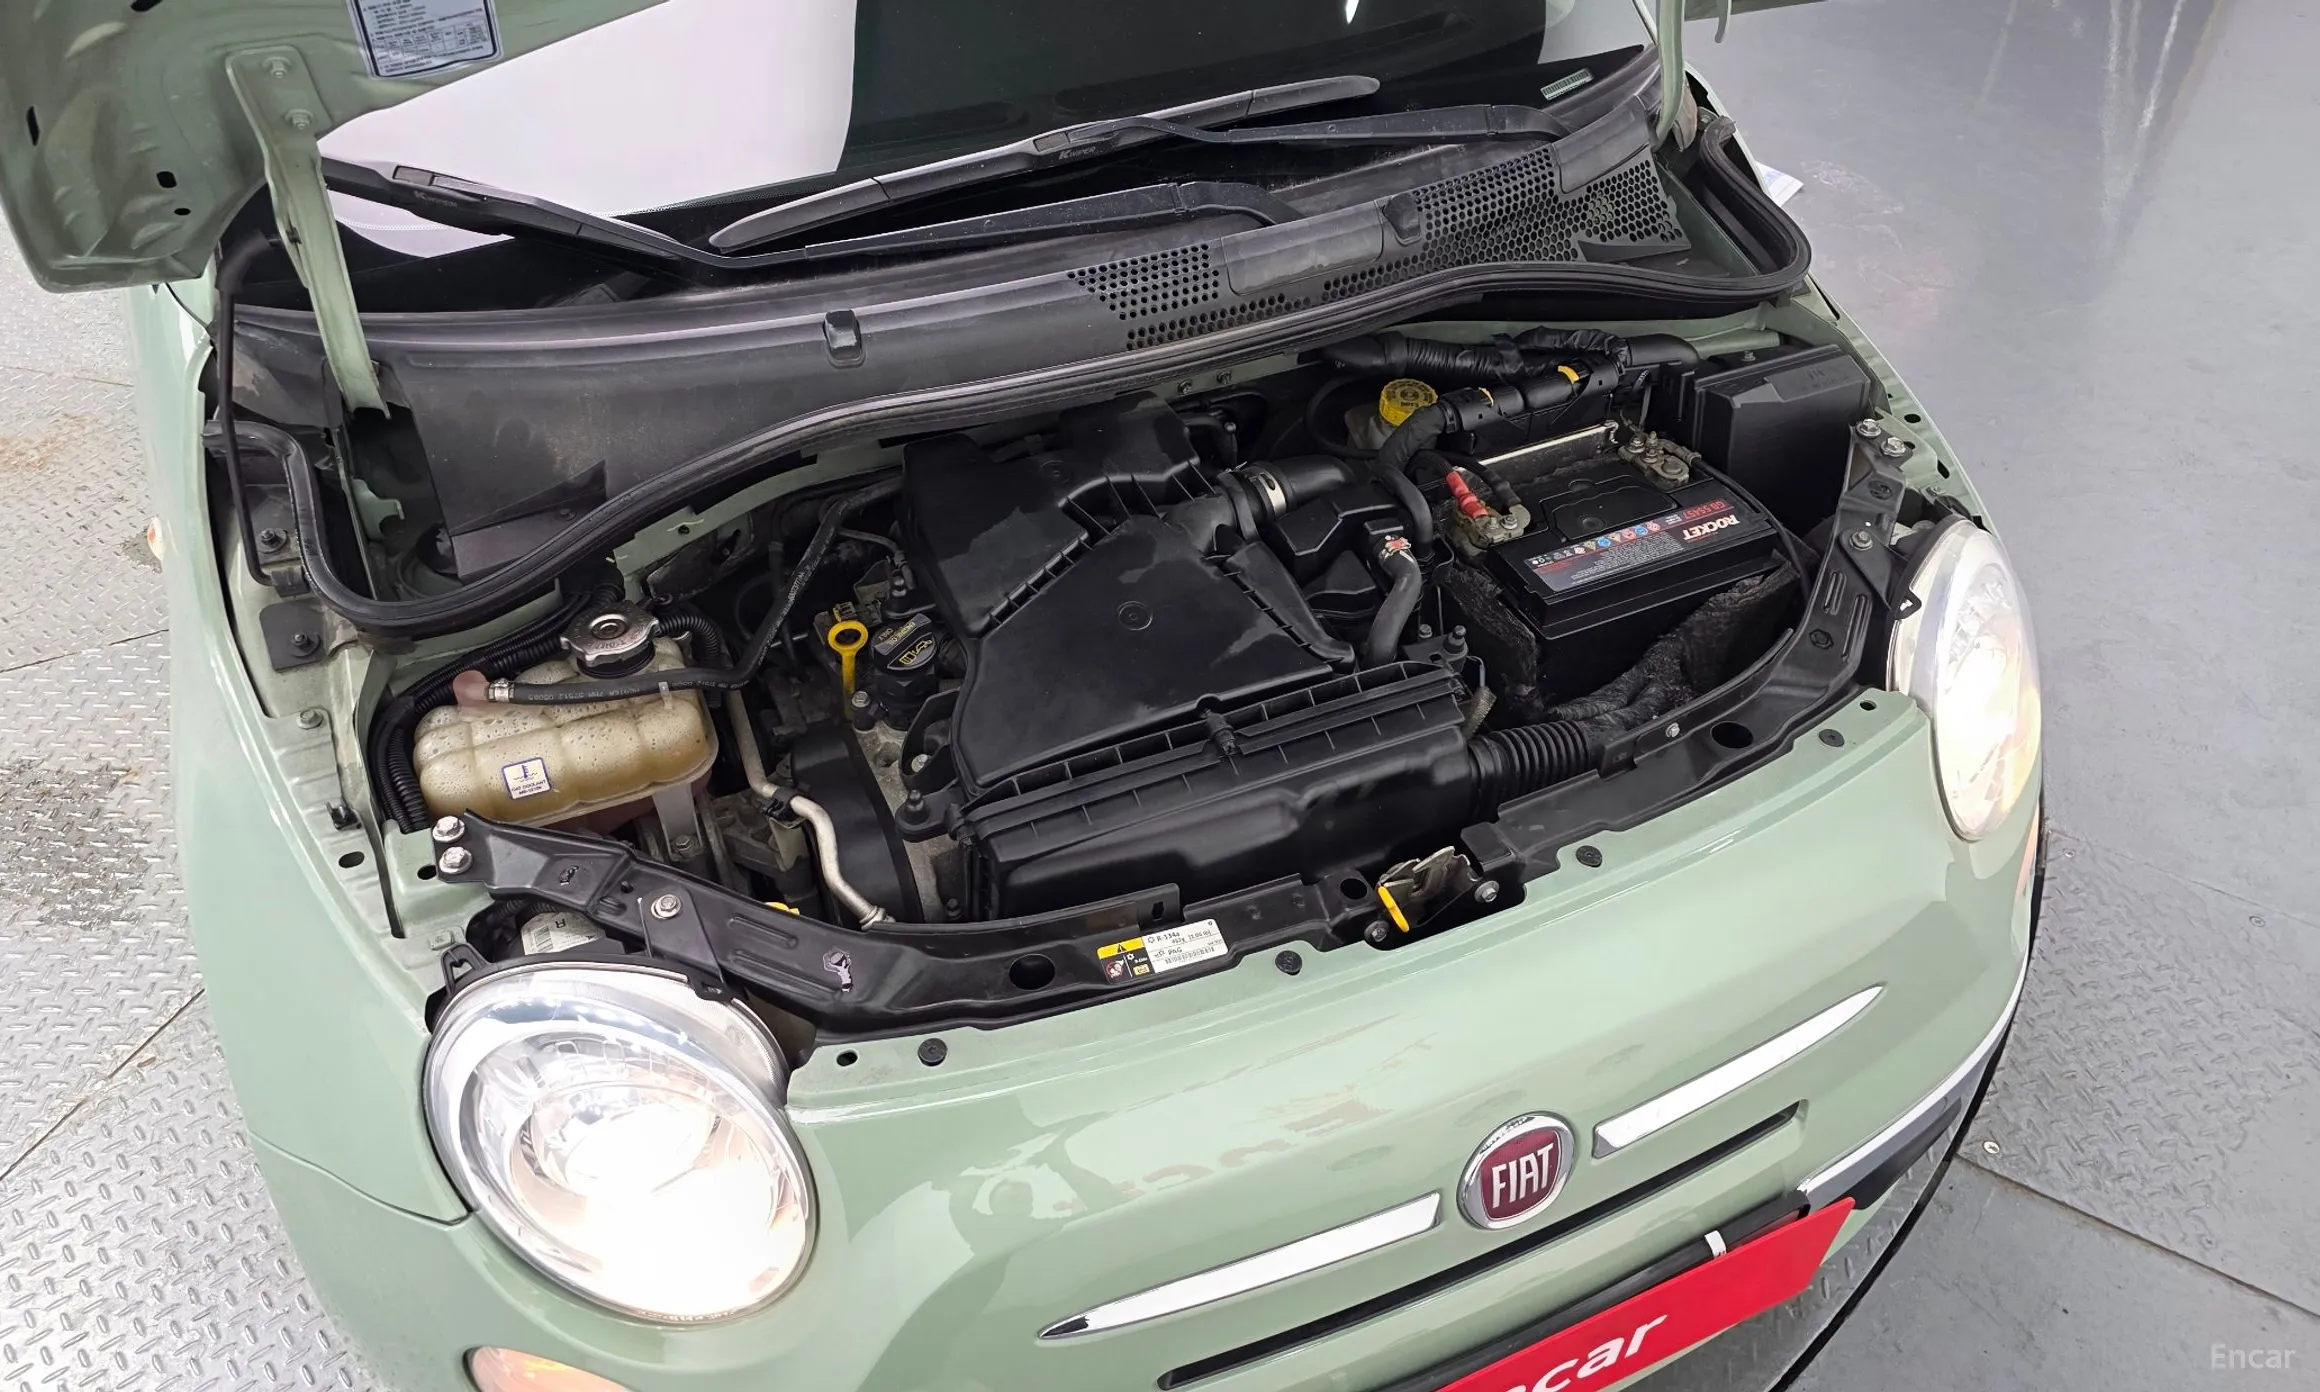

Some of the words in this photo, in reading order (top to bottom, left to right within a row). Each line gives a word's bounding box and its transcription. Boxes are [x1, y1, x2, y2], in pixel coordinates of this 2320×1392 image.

[1682, 514, 1741, 541] ROCKET
[554, 918, 567, 929] R
[1167, 947, 1183, 955] PAG
[1491, 1142, 1555, 1209] FIAT
